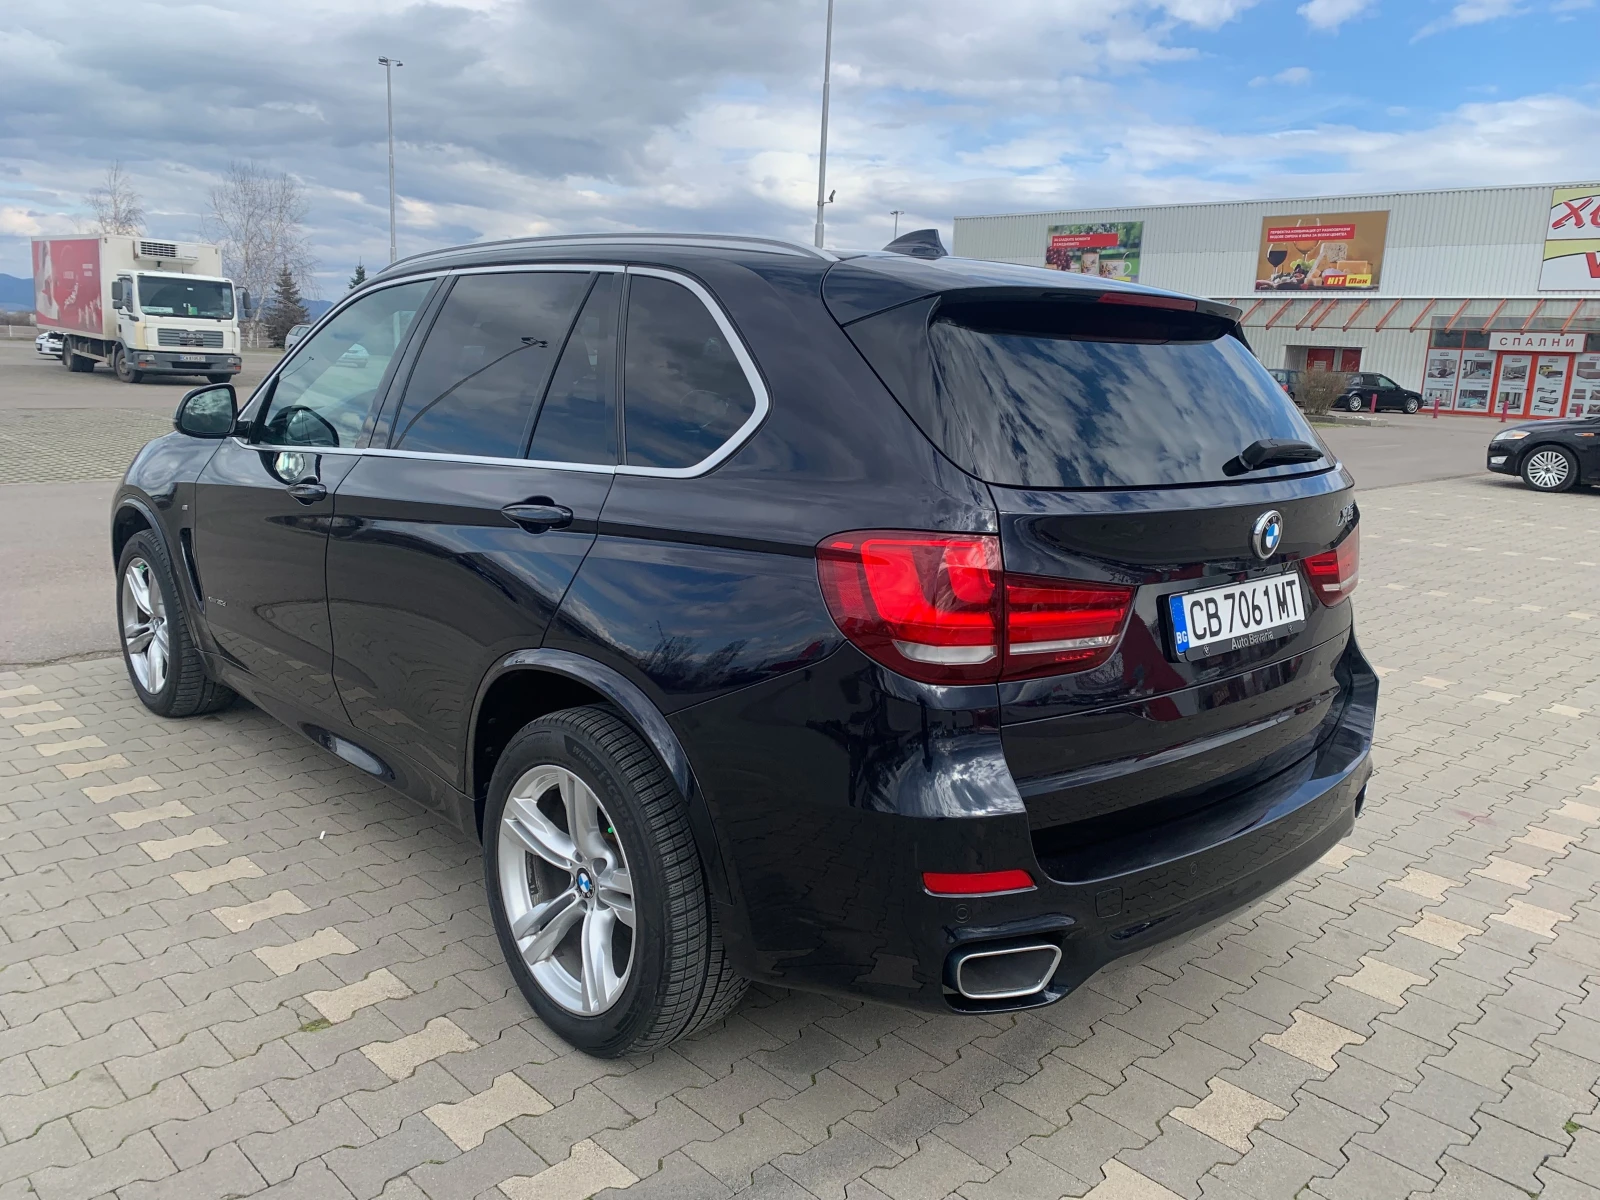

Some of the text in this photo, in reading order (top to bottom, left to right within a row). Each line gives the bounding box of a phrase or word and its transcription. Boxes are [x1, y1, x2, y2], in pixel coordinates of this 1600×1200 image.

[1327, 276, 1344, 284] HIT
[1500, 337, 1575, 347] СПАЛНИ
[1190, 580, 1297, 640] CB 7061 MT
[1176, 630, 1188, 644] BG
[1231, 629, 1274, 650] Auto Bavaria
